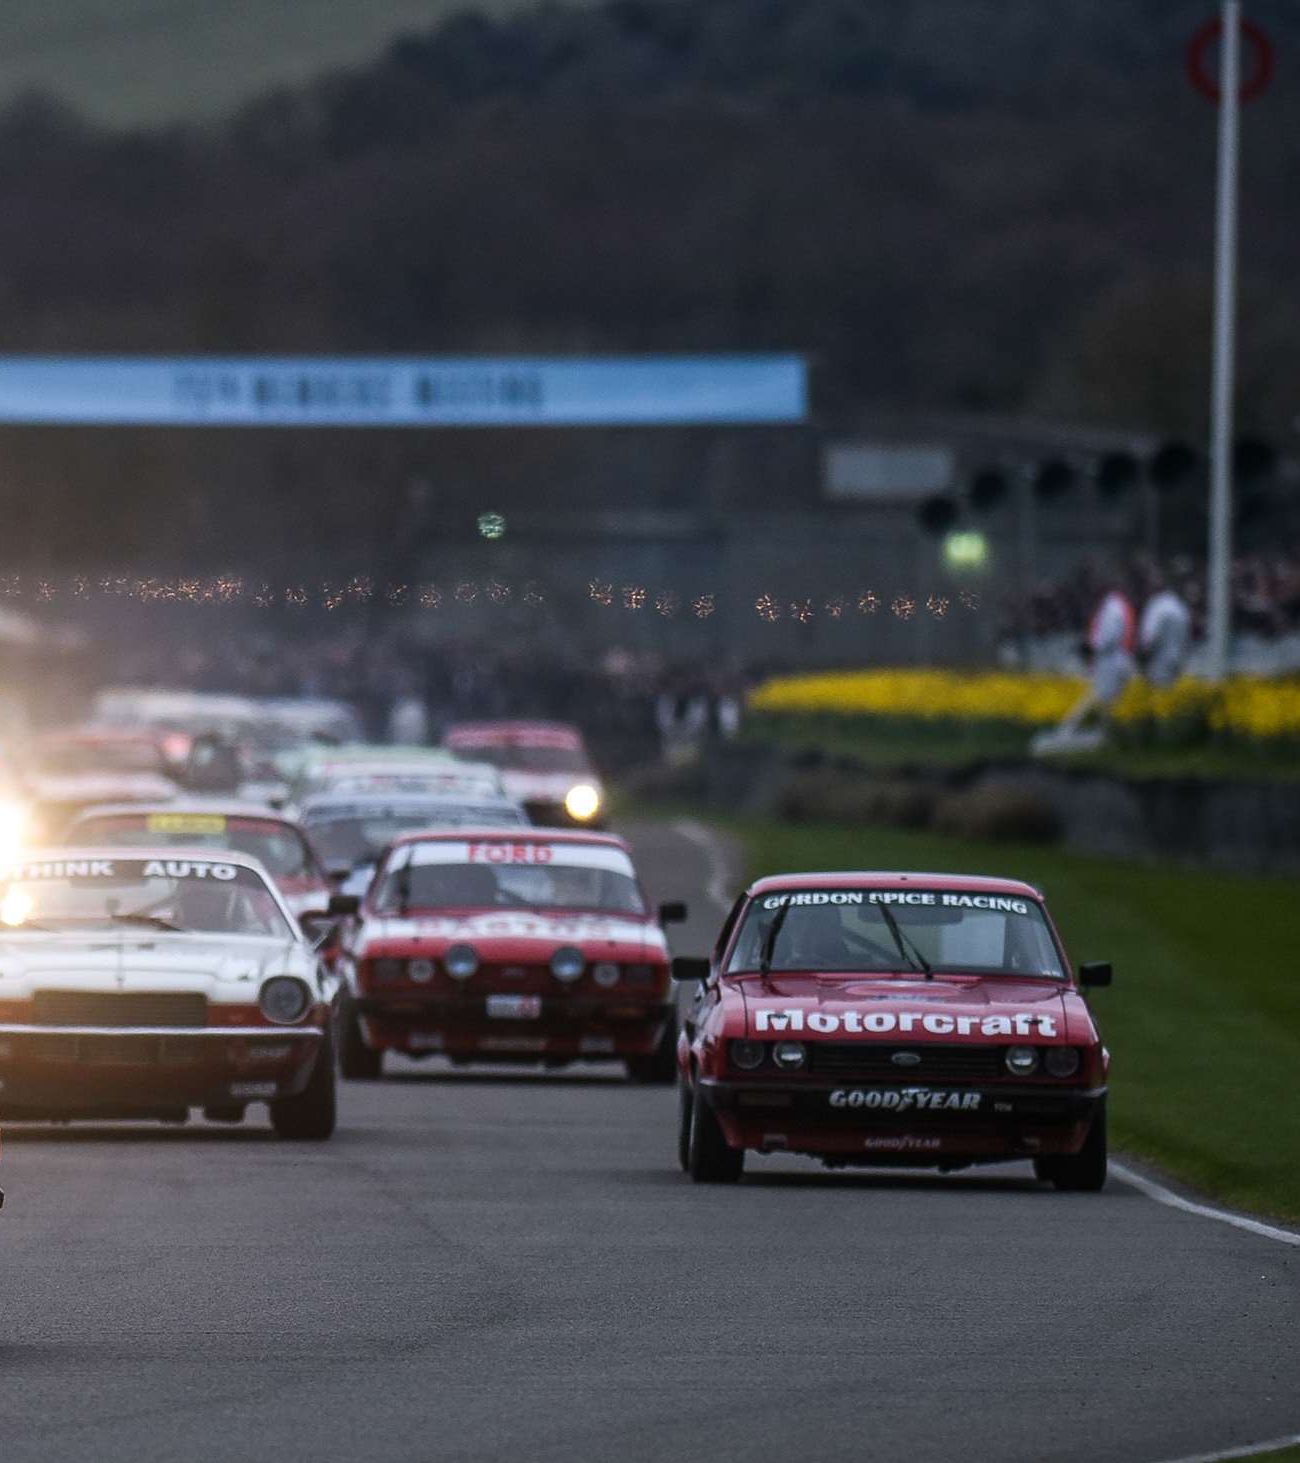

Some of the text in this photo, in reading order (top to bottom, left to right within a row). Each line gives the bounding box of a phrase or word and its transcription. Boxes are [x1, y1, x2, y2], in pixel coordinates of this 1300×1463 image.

[467, 844, 554, 864] FORD
[12, 861, 237, 880] THINK AUTO
[763, 892, 863, 910] GORDON
[941, 894, 1028, 914] RACING
[754, 1007, 1058, 1038] Motorcraft
[829, 1088, 983, 1112] GOODYEAR
